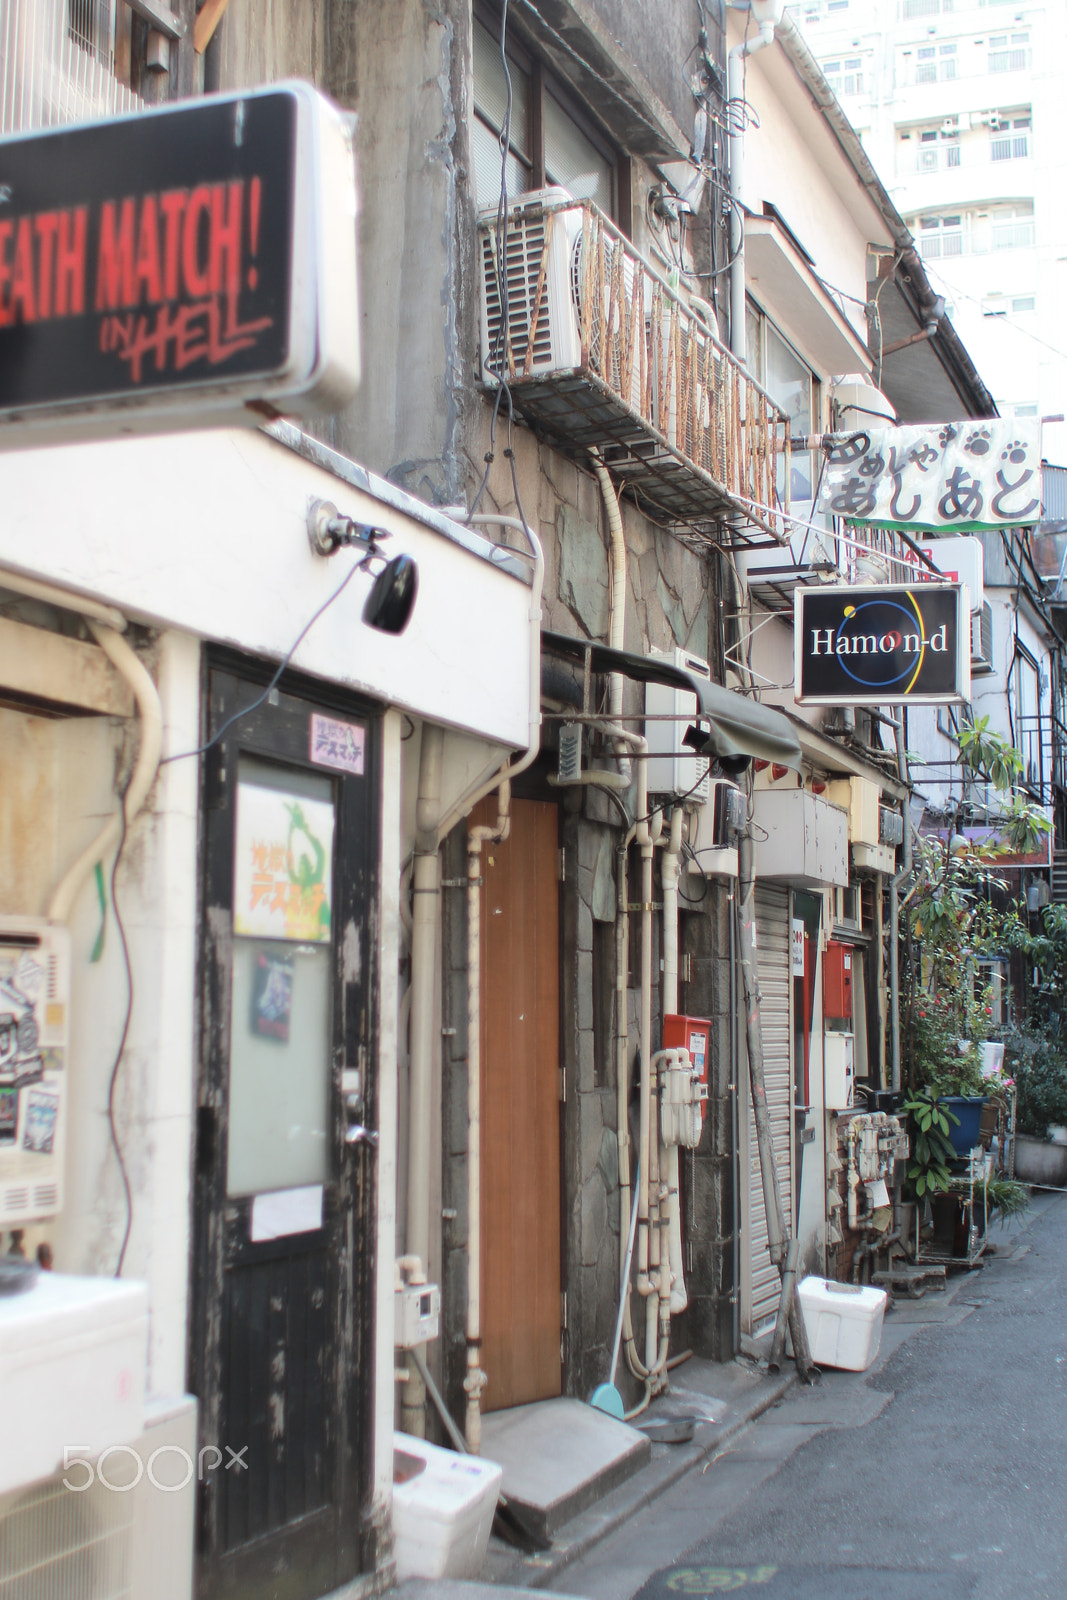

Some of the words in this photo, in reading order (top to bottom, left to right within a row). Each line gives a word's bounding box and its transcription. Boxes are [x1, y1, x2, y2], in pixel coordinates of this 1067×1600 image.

[97, 176, 260, 311] MATCH!
[830, 466, 1039, 521] あしあと
